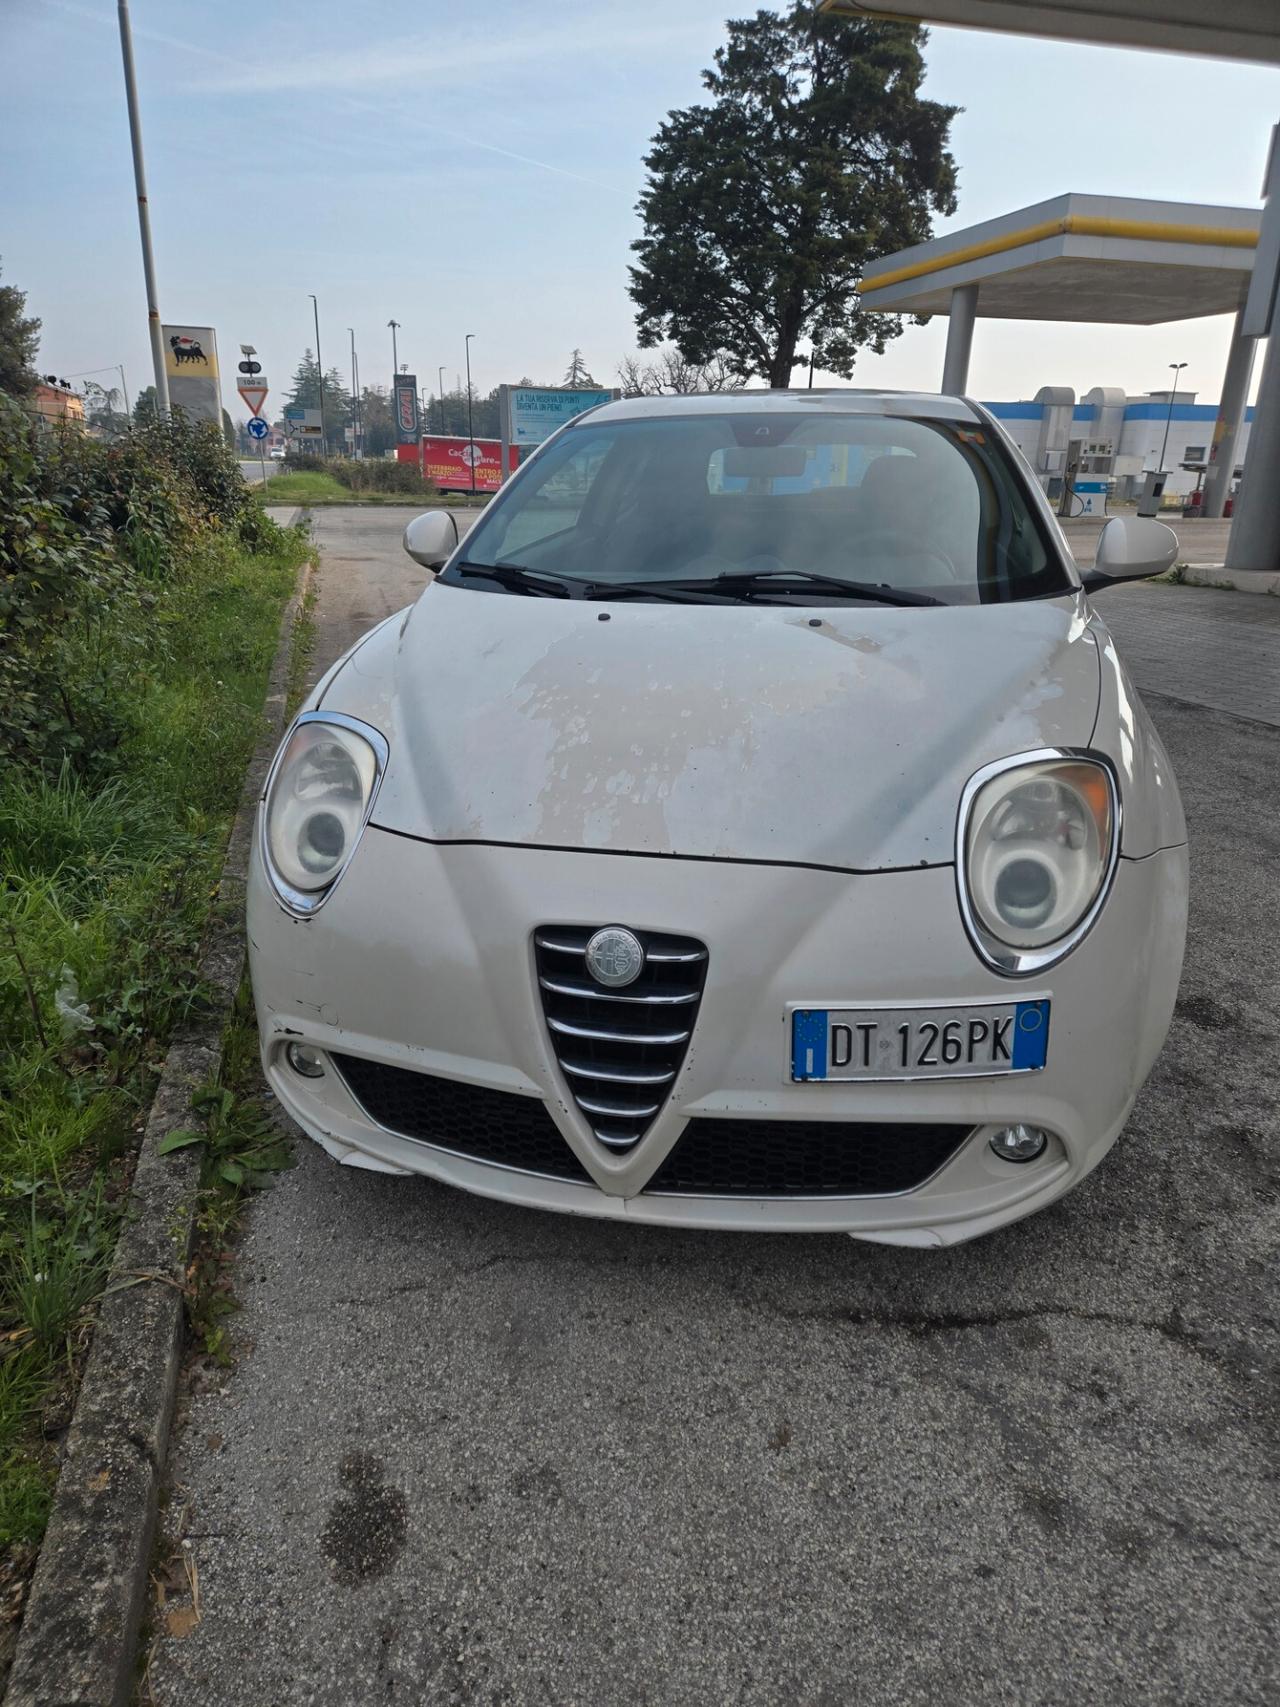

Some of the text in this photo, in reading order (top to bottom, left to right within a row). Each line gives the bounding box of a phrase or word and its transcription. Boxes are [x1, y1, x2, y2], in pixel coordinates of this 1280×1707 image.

[516, 393, 525, 402] LA
[525, 394, 536, 402] TUA
[516, 402, 539, 411] DIVENTA
[831, 1022, 877, 1067] DT
[897, 1016, 1014, 1067] 126PK
